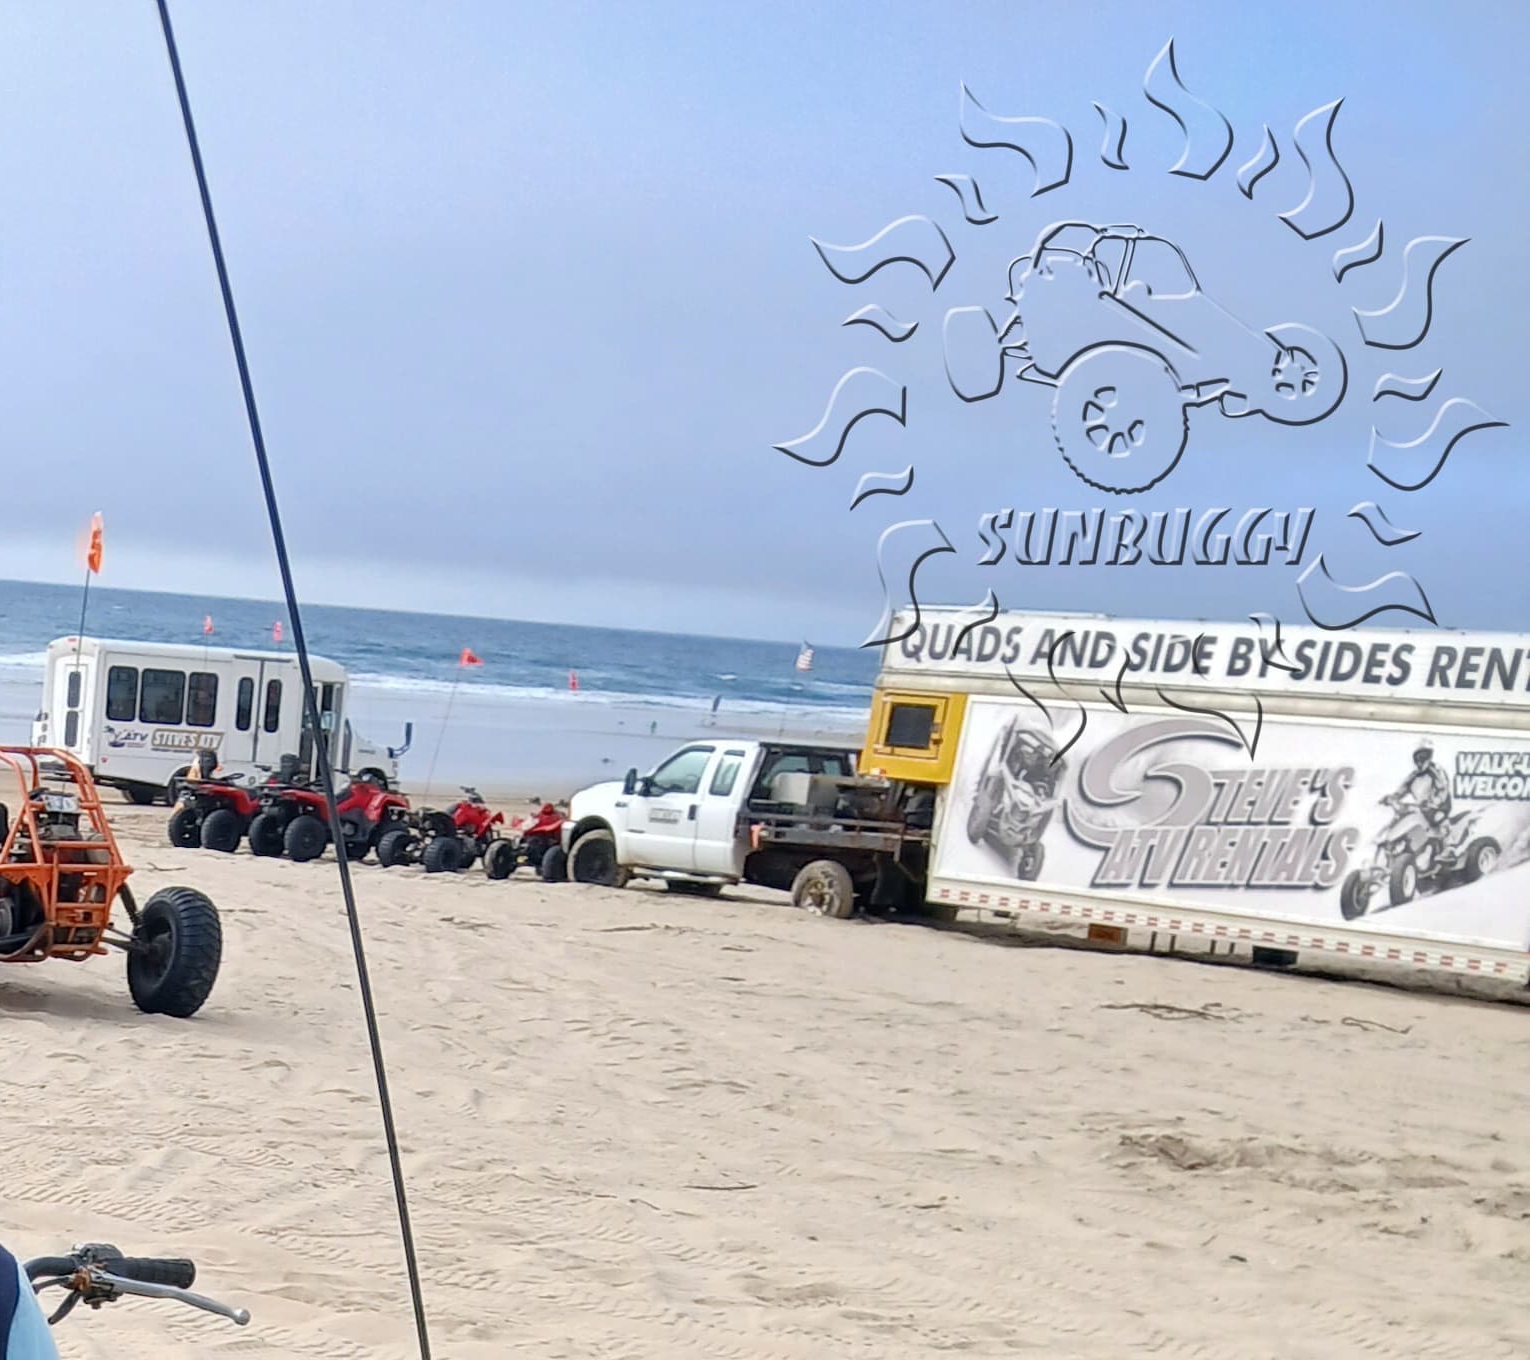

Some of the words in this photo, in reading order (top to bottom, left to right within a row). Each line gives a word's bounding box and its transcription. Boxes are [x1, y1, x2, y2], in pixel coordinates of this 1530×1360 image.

[901, 622, 1023, 664] QUADS
[1029, 627, 1118, 669] AND
[1126, 631, 1218, 675] SIDE
[1226, 636, 1285, 678] BY
[1289, 638, 1416, 686] SIDES
[1070, 719, 1356, 850] STEVE'S
[1090, 826, 1190, 888] ATV
[1167, 826, 1360, 890] RENTALS
